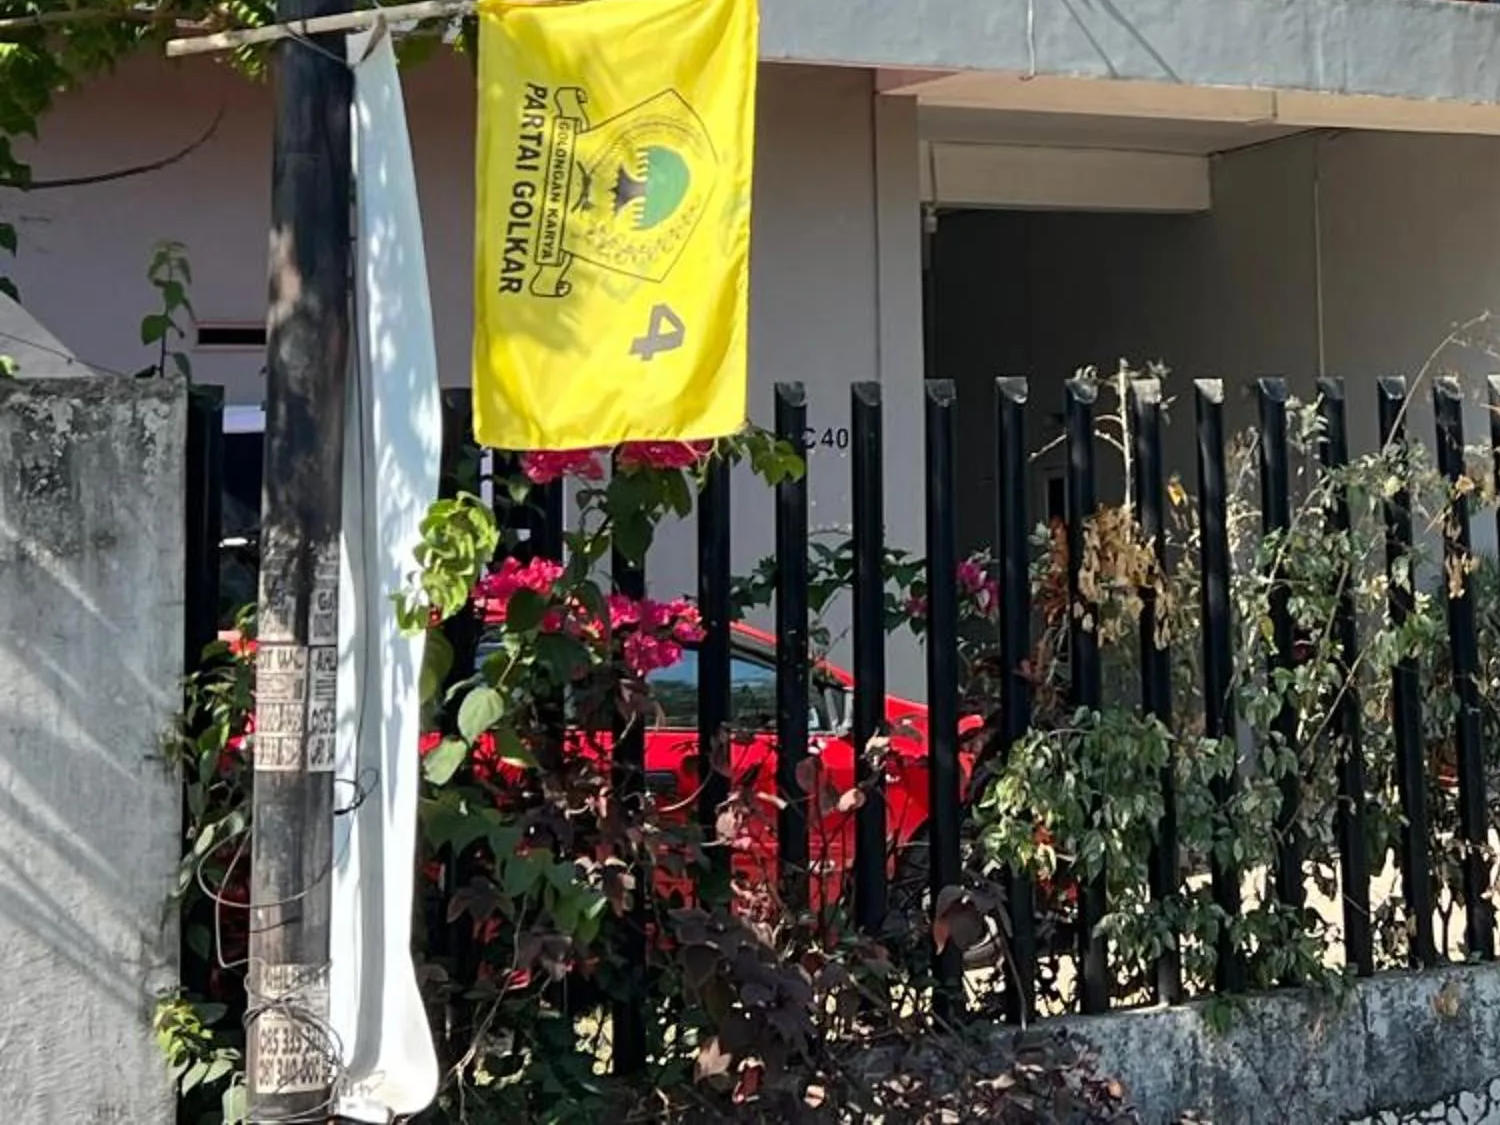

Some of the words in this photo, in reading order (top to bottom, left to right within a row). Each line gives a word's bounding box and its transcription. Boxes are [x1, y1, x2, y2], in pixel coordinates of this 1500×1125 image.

[515, 82, 548, 172] PARTAI
[551, 121, 570, 203] GOLONGAN
[498, 180, 536, 294] GOLKAR
[541, 208, 559, 260] KARYA
[628, 303, 686, 362] 4
